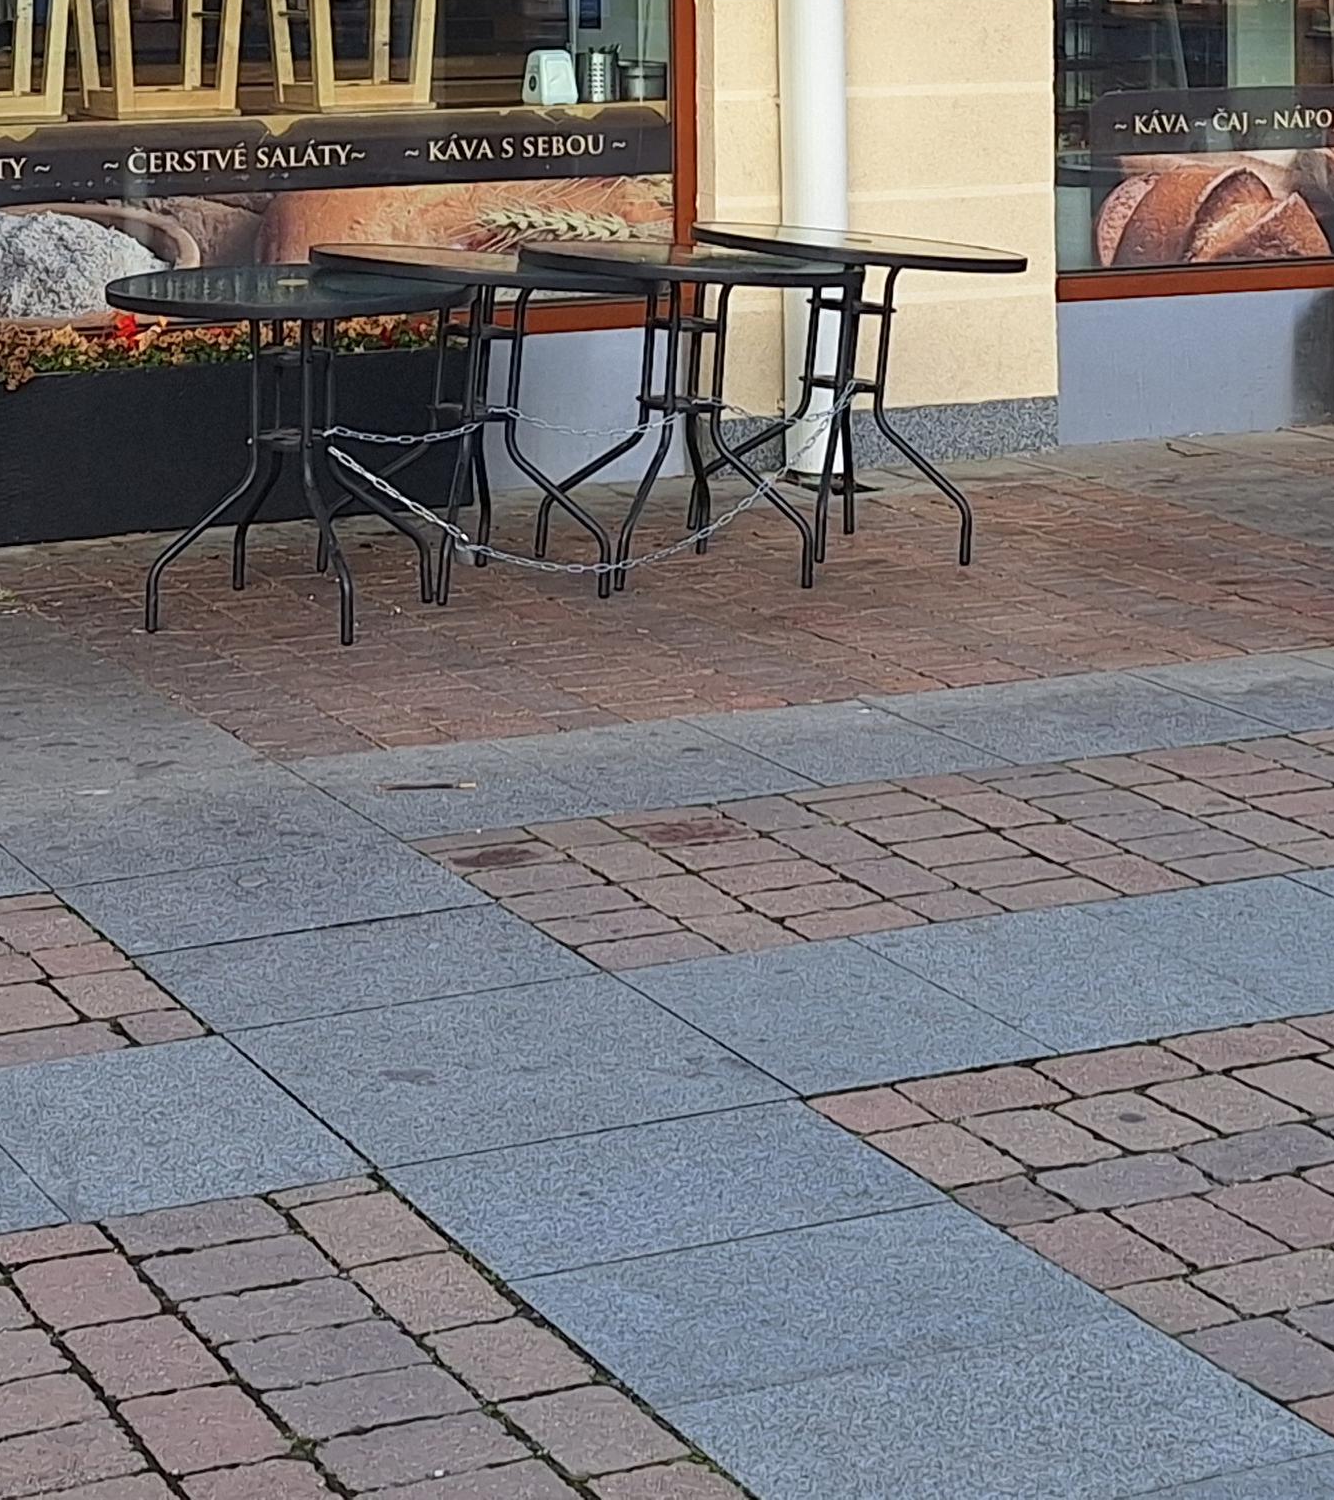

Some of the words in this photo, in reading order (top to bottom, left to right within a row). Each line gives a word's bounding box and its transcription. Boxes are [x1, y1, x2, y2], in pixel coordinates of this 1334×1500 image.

[1134, 109, 1190, 135] KÁVA
[1212, 107, 1249, 134] ČAJ
[127, 142, 249, 175] ČERSTVÉ
[256, 138, 352, 170] SALÁTY
[427, 133, 496, 163] KÁVA
[501, 137, 515, 159] S
[521, 134, 605, 159] SEBOU
